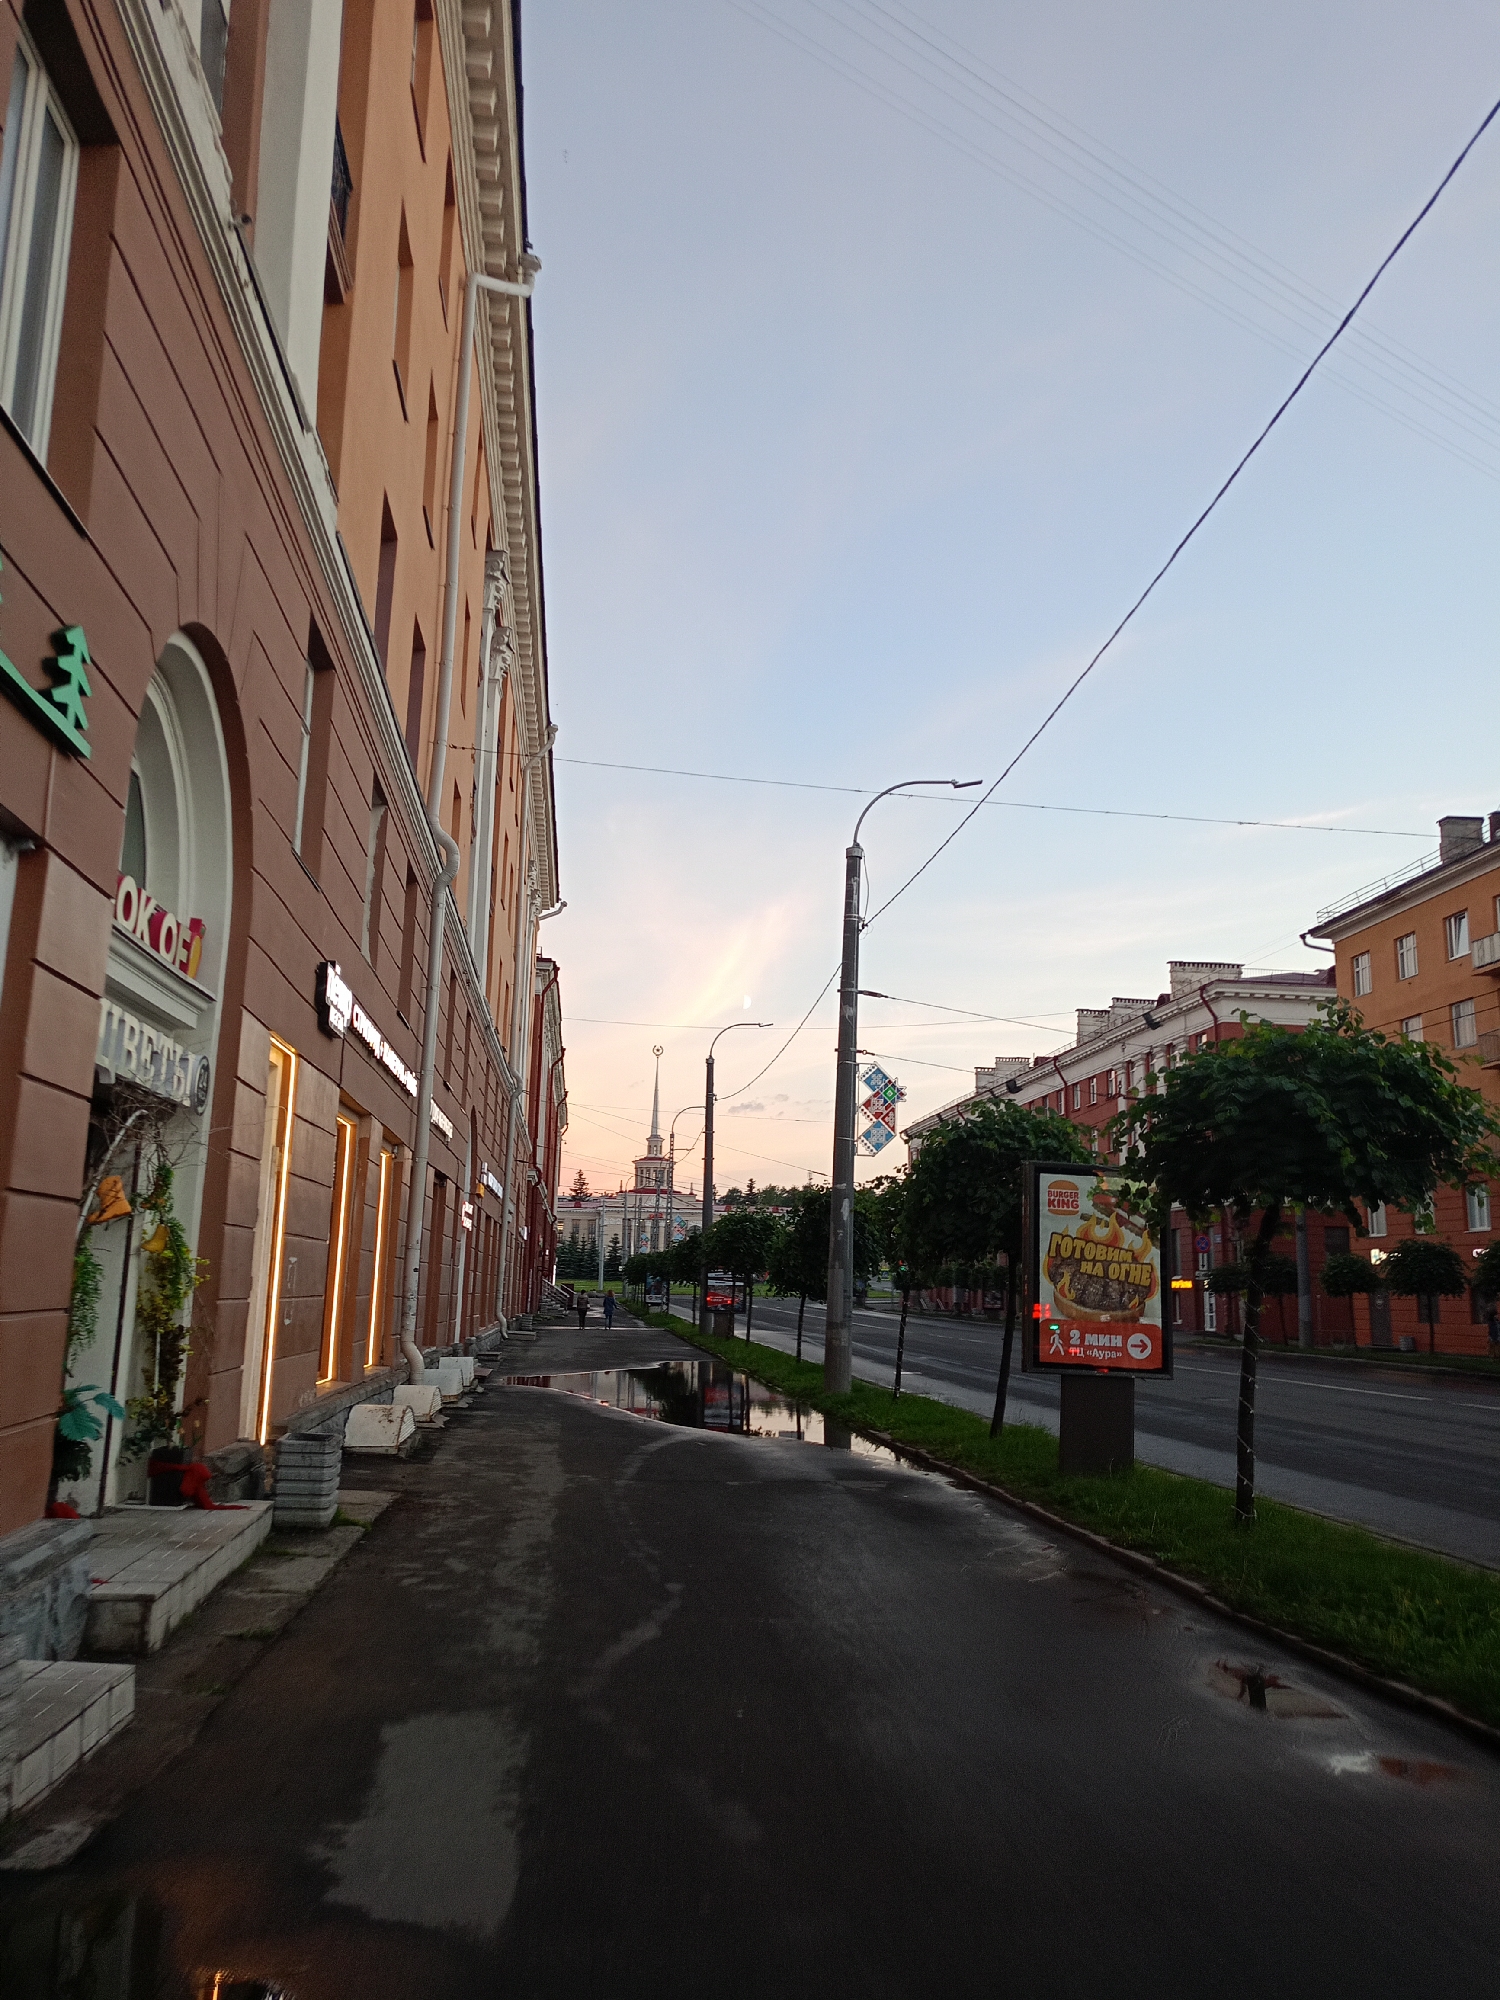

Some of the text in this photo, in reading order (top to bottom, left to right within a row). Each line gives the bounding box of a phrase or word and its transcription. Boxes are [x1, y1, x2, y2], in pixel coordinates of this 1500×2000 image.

[95, 997, 197, 1108] ЦВЕТЫ
[1048, 1190, 1079, 1200] BURGER
[1048, 1198, 1080, 1209] KING
[1049, 1233, 1133, 1263] ГОТОВИМ
[1080, 1261, 1104, 1277] НА
[1108, 1262, 1152, 1287] ОГНЕ
[1070, 1329, 1080, 1345] 2
[1069, 1346, 1123, 1360] ТЦ «Аура»
